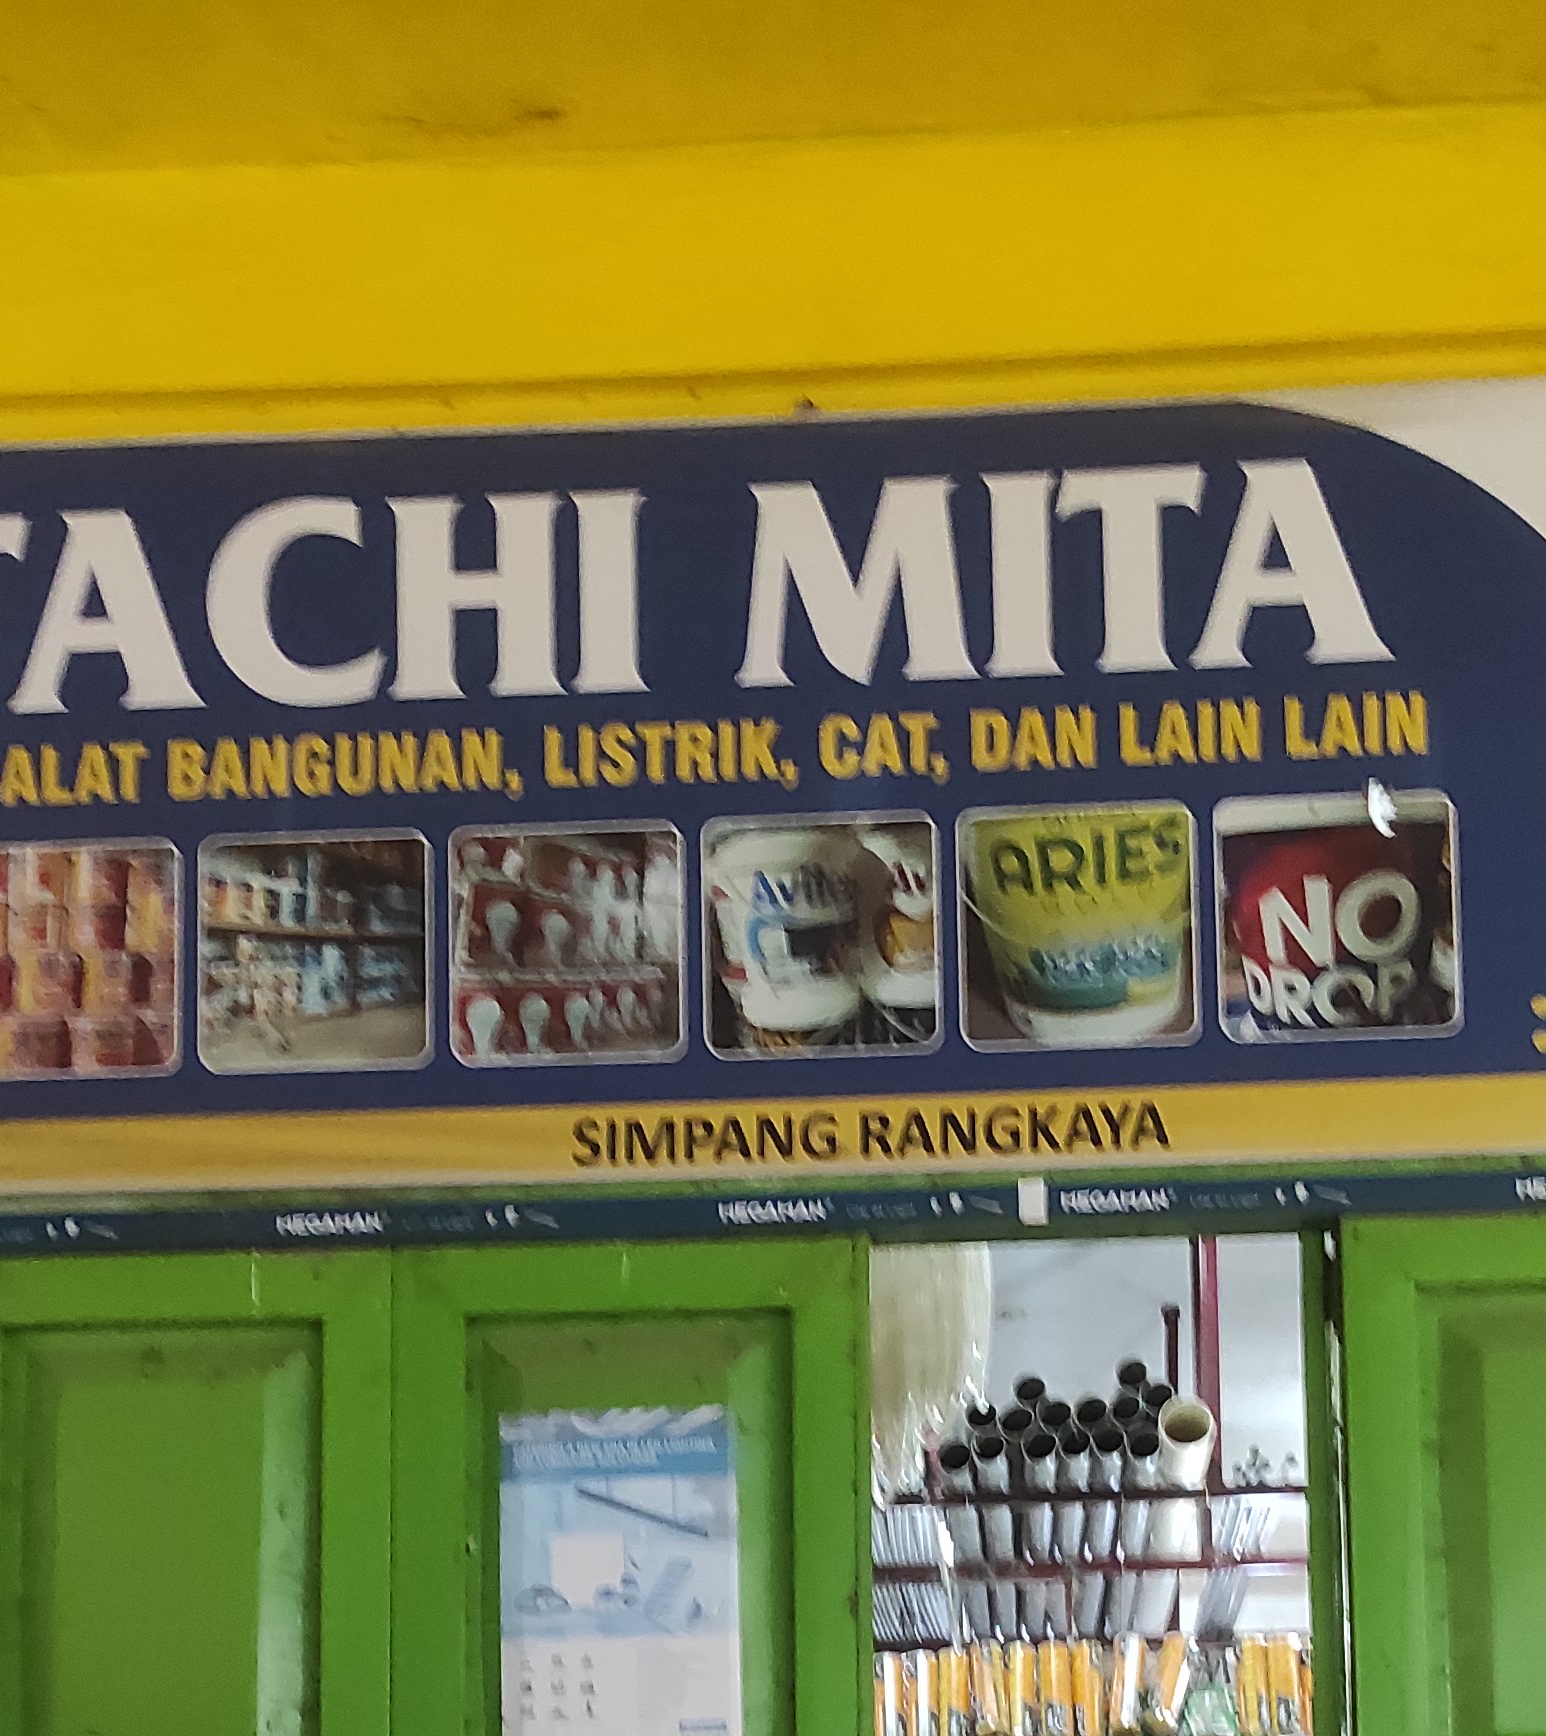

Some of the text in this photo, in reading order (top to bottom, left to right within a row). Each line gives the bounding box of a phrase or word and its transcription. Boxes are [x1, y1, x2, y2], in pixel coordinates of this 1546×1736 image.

[734, 456, 1397, 690] MITA
[166, 728, 522, 801] BANGUNAN,
[543, 716, 798, 791] LISTRIK,
[818, 711, 949, 784] CAT,
[970, 705, 1095, 773] DAN
[1118, 696, 1262, 767] LAIN
[1285, 690, 1428, 761] LAIN
[991, 815, 1180, 895] ARIES
[1258, 868, 1420, 968] NO
[1242, 954, 1415, 1027] DROP
[572, 1099, 1171, 1168] SIMPANG RANGKAYA
